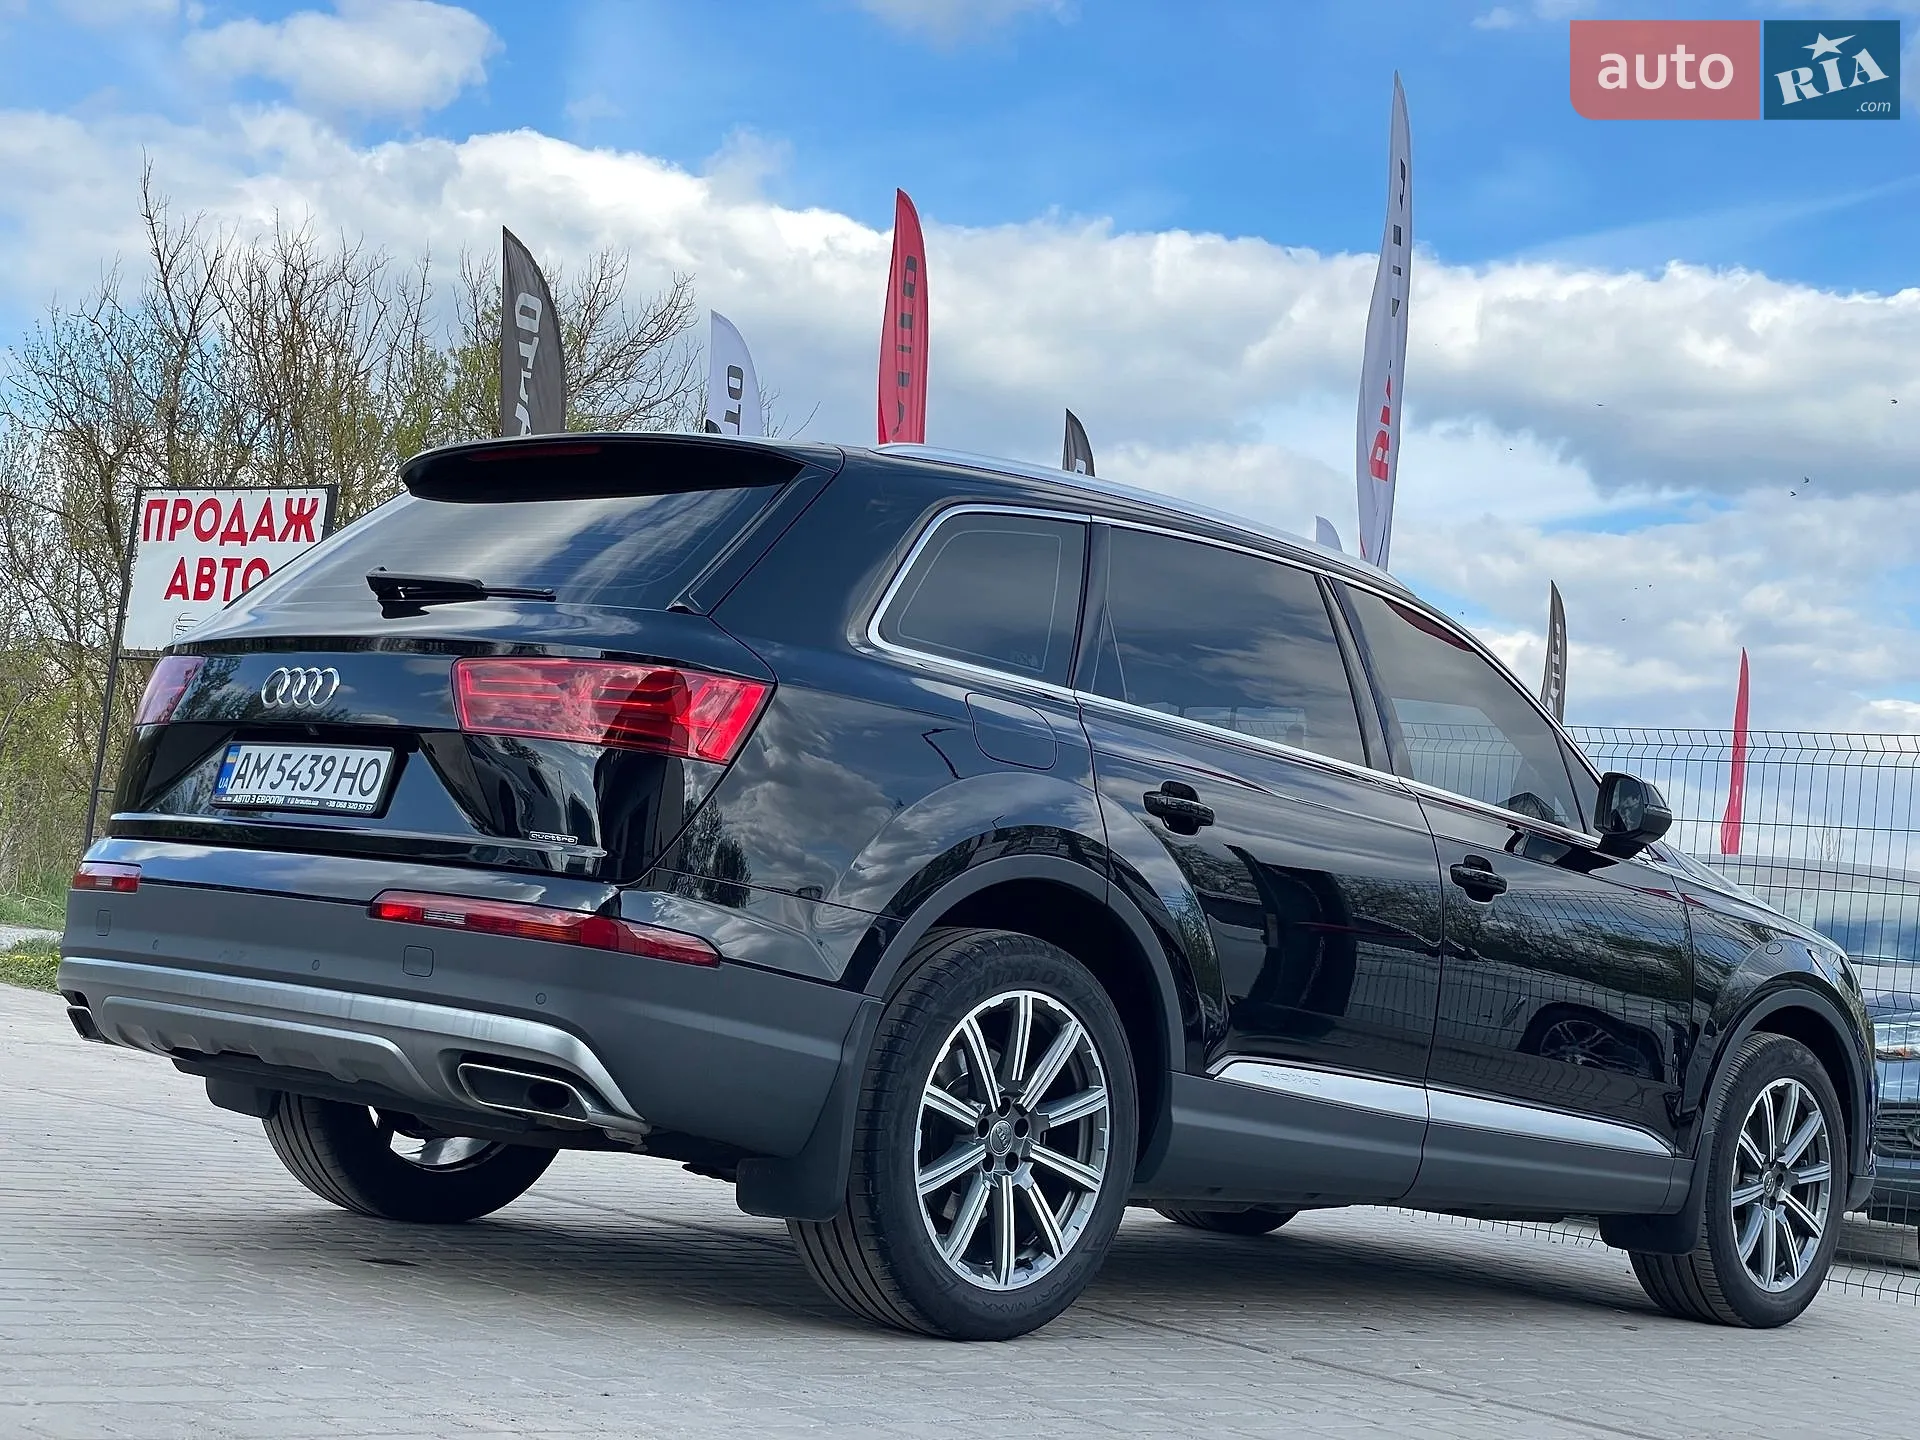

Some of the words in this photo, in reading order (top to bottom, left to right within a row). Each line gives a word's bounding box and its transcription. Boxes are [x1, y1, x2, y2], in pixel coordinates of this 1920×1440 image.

[143, 497, 319, 546] ПРОДАЖ
[164, 557, 270, 601] АВТО
[218, 777, 228, 789] UA
